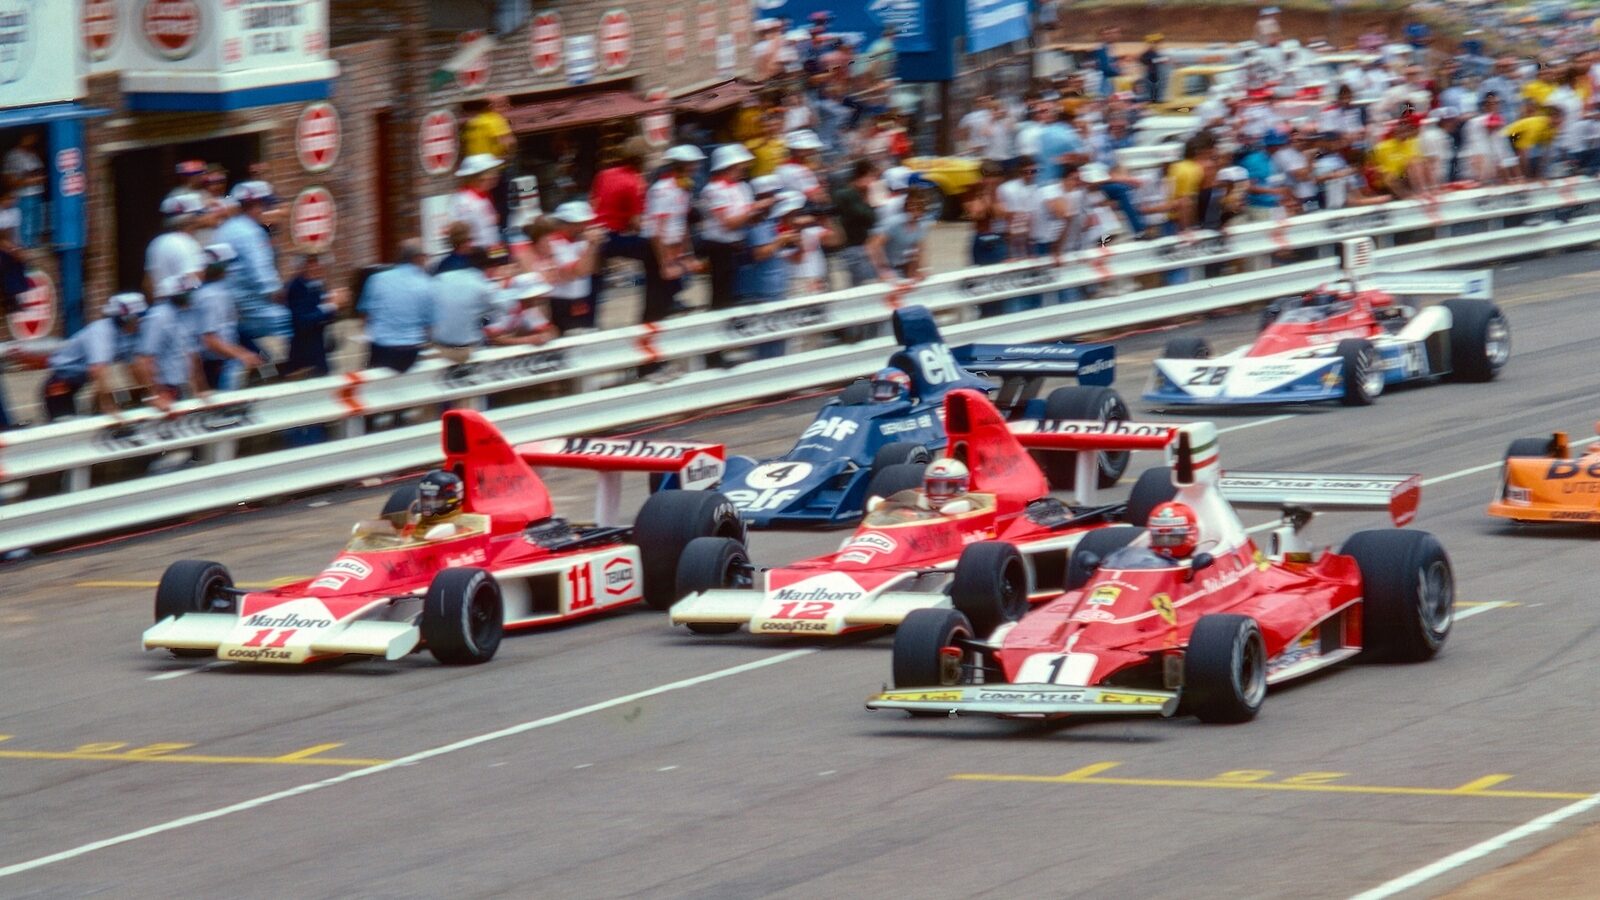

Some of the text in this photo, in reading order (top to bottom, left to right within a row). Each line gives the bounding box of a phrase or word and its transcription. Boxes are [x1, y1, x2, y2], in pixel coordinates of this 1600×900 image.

[919, 344, 961, 385] elf
[1183, 366, 1230, 387] 28
[800, 417, 859, 441] elf
[1036, 420, 1178, 434] Marlbor
[558, 438, 695, 457] Marlbor
[767, 463, 798, 482] 4
[724, 489, 800, 512] elf
[568, 562, 594, 611] 11
[772, 587, 862, 600] Marlboro
[770, 602, 835, 619] 12
[243, 614, 331, 628] Marlboro
[242, 629, 298, 647] 11
[1046, 655, 1068, 684] 1
